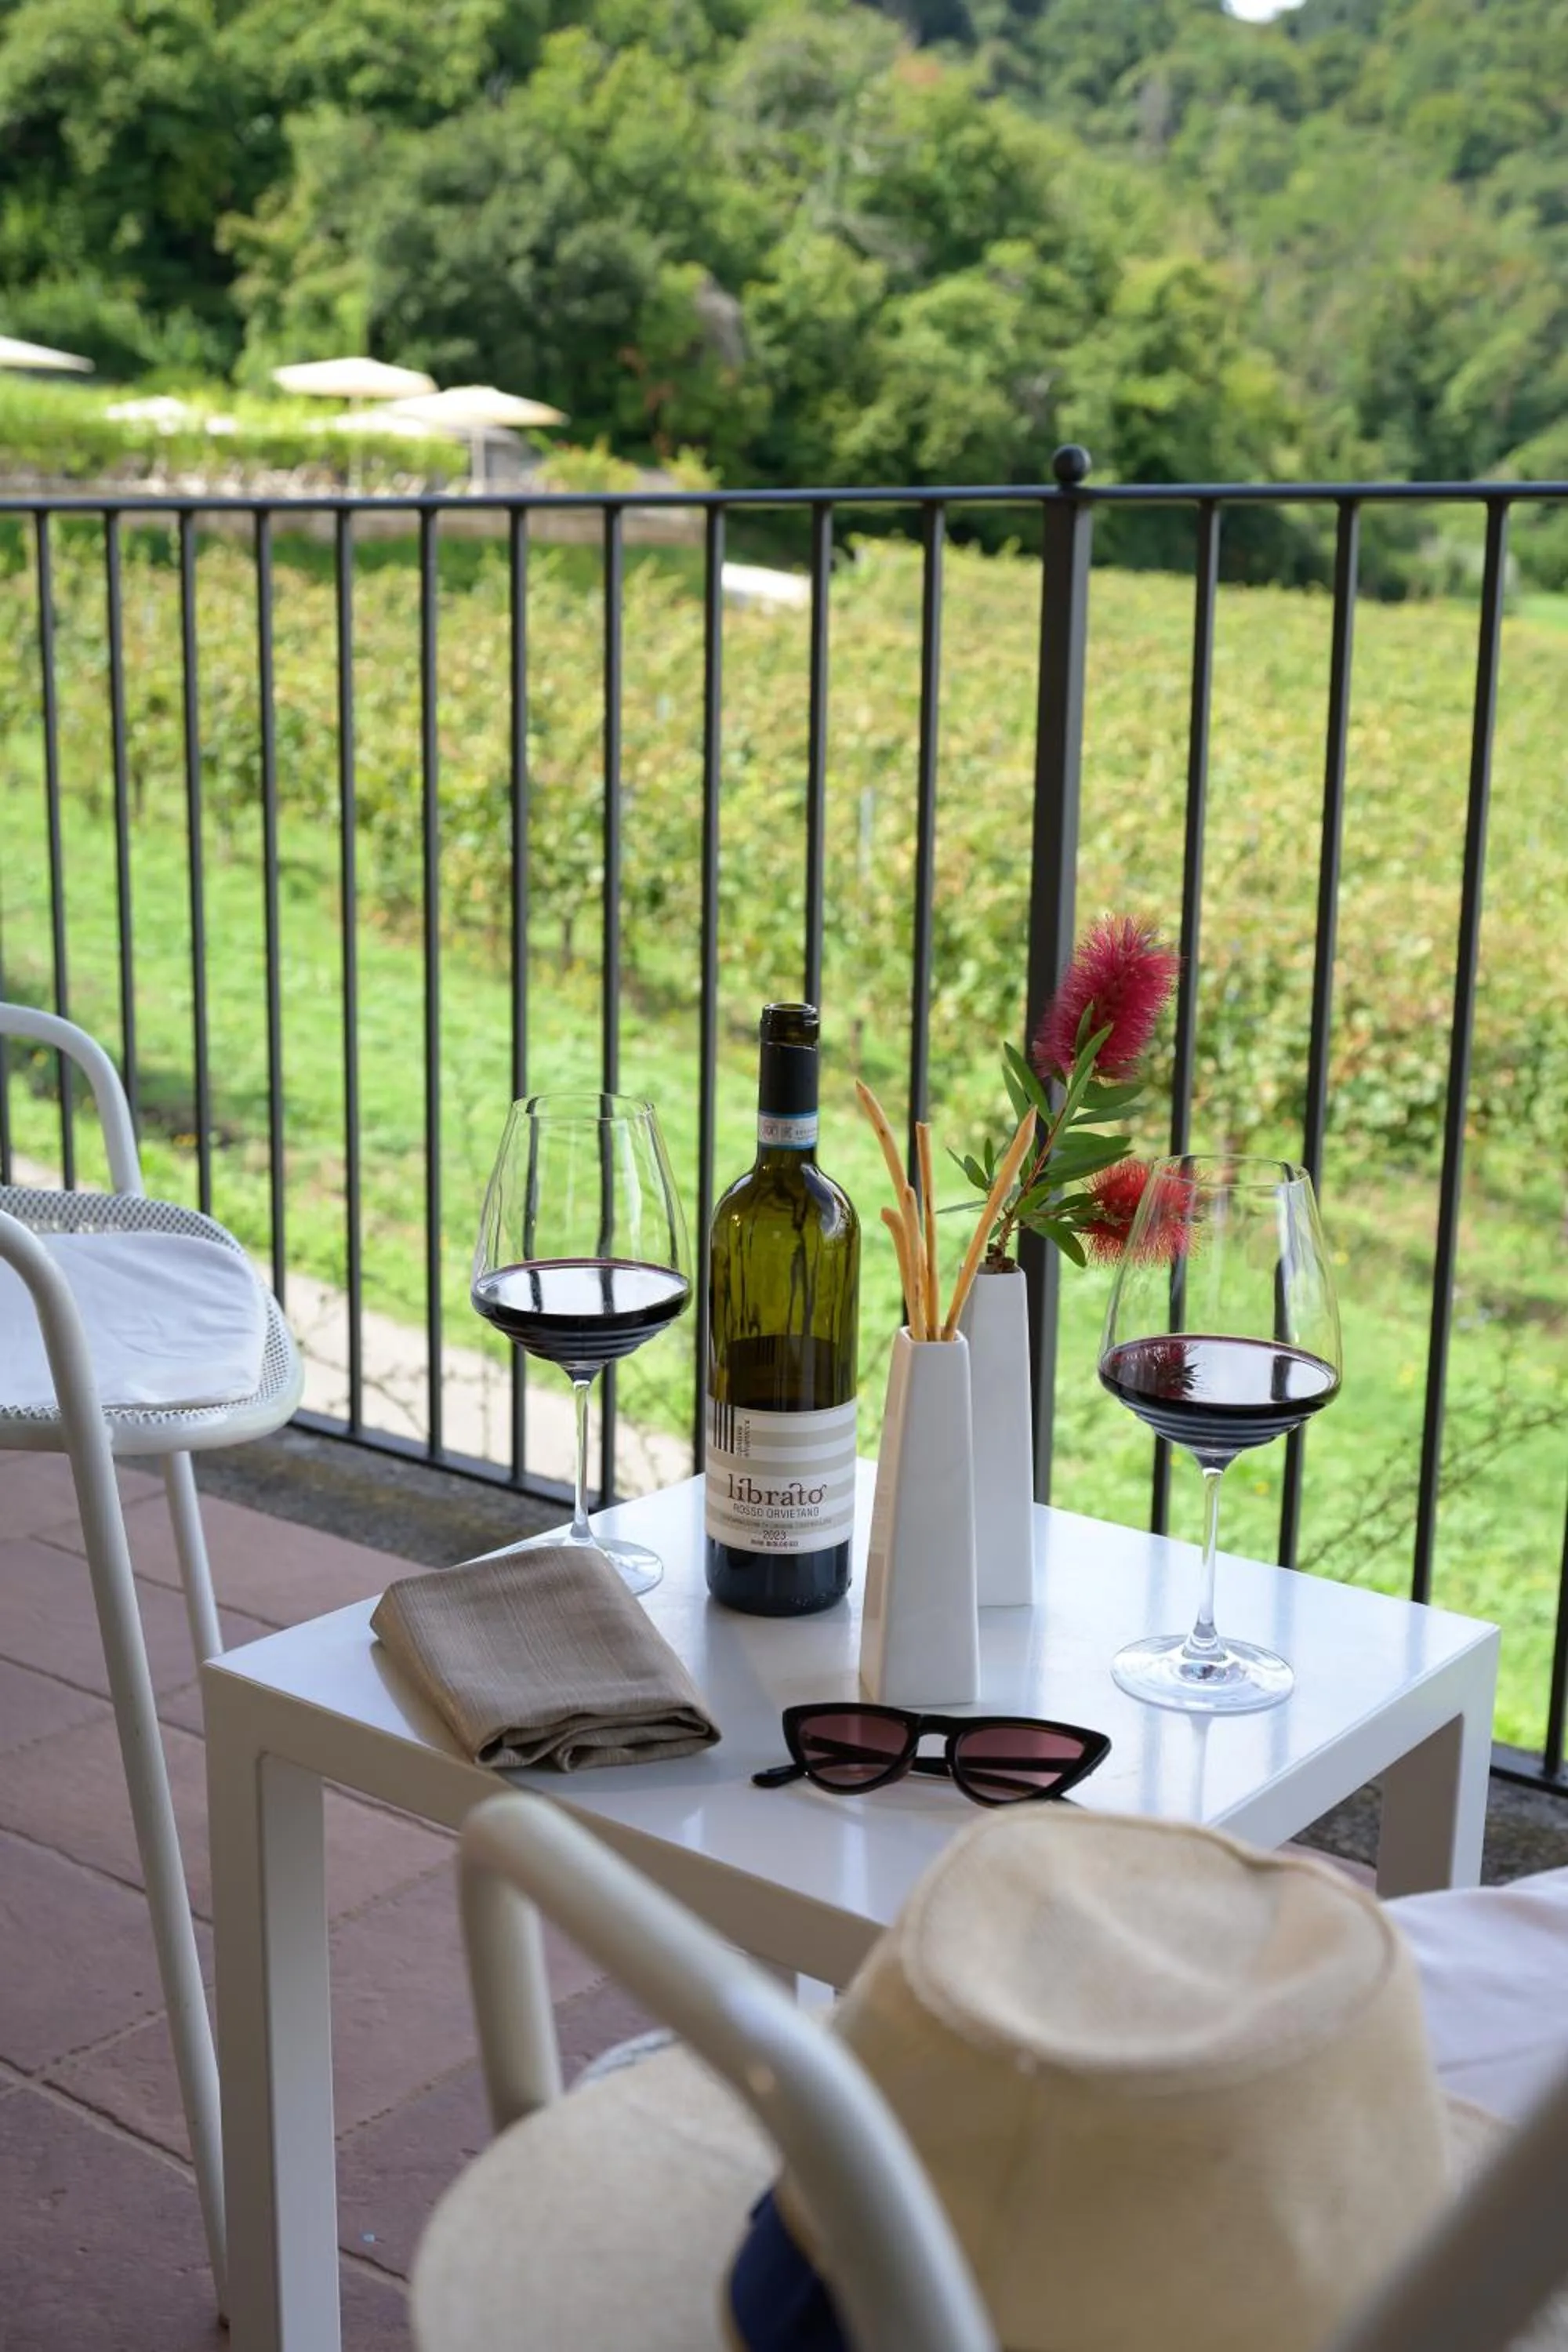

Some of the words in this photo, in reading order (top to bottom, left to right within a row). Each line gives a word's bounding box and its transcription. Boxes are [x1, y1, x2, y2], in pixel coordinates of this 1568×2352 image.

[727, 1473, 827, 1506] librato
[733, 1503, 763, 1517] ROSSO
[766, 1506, 819, 1519] ORVIETANO
[763, 1530, 786, 1541] 2023
